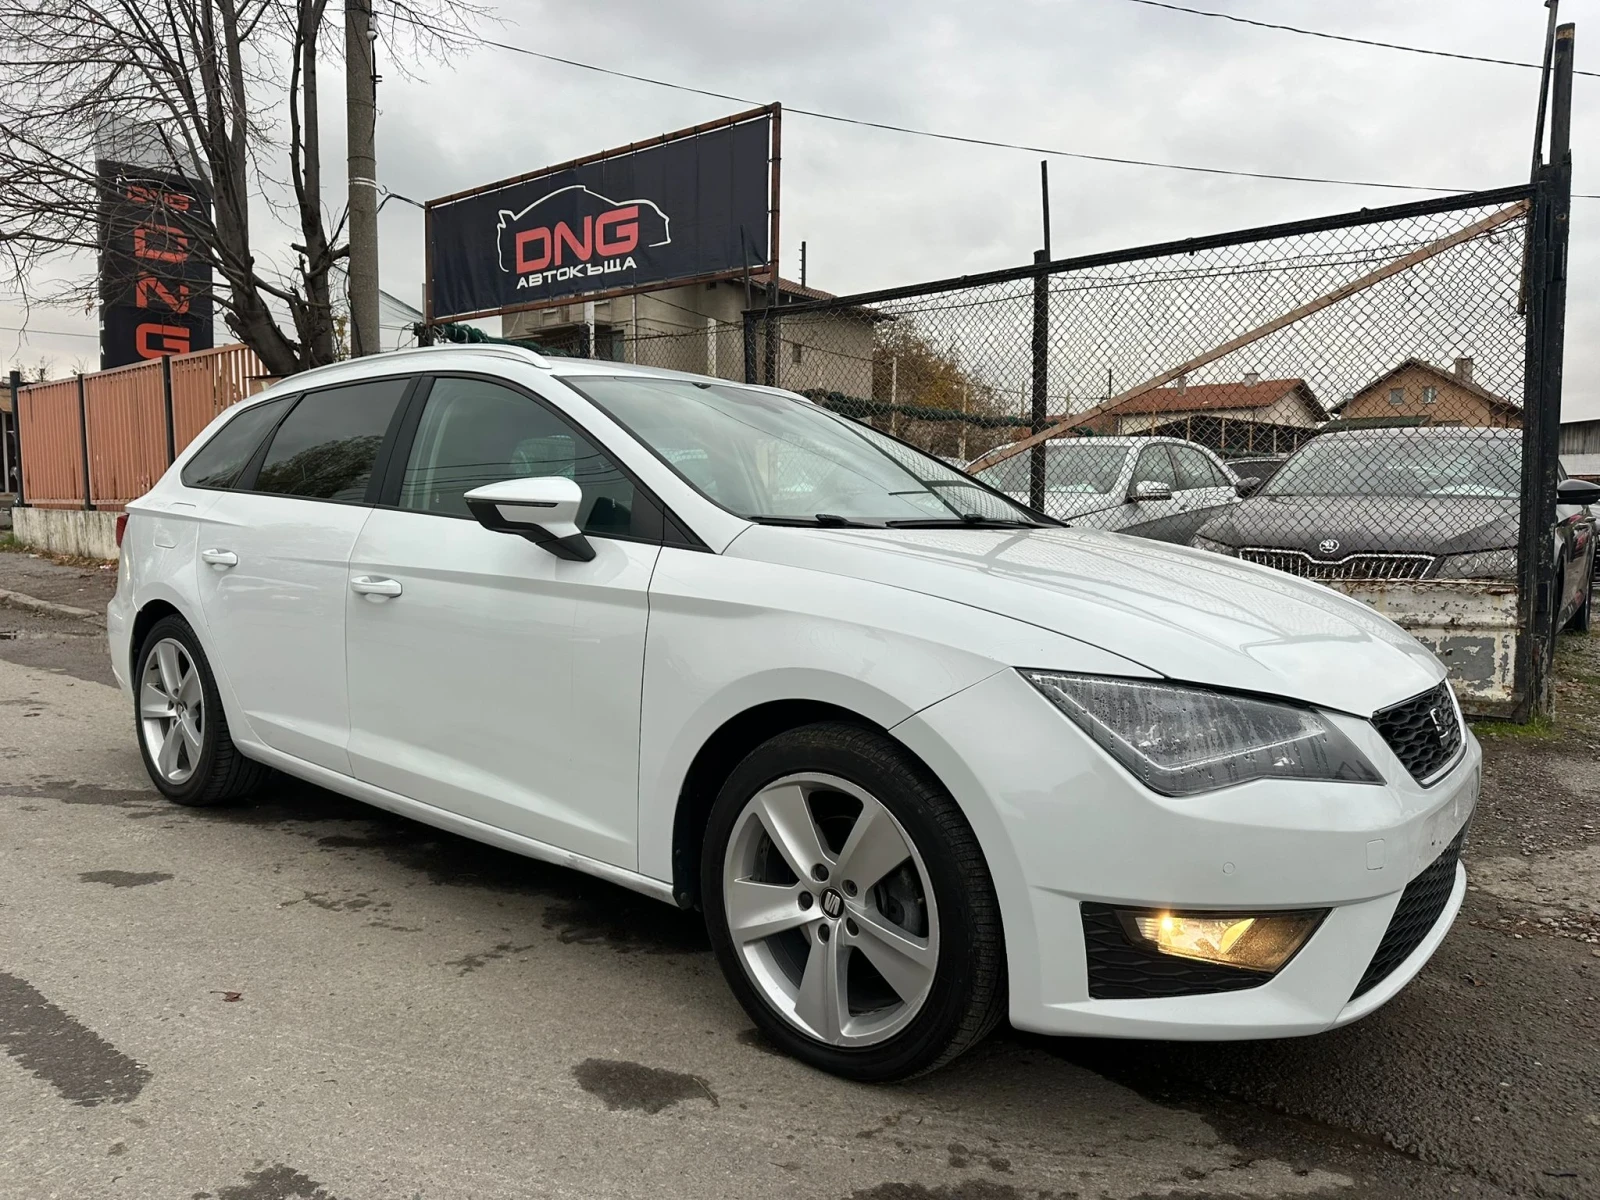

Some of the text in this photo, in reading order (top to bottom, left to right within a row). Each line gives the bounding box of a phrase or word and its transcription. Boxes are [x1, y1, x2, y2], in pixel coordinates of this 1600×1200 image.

[515, 205, 639, 275] DNG
[516, 256, 638, 290] АВТОКЪЩА
[133, 223, 190, 360] DNG
